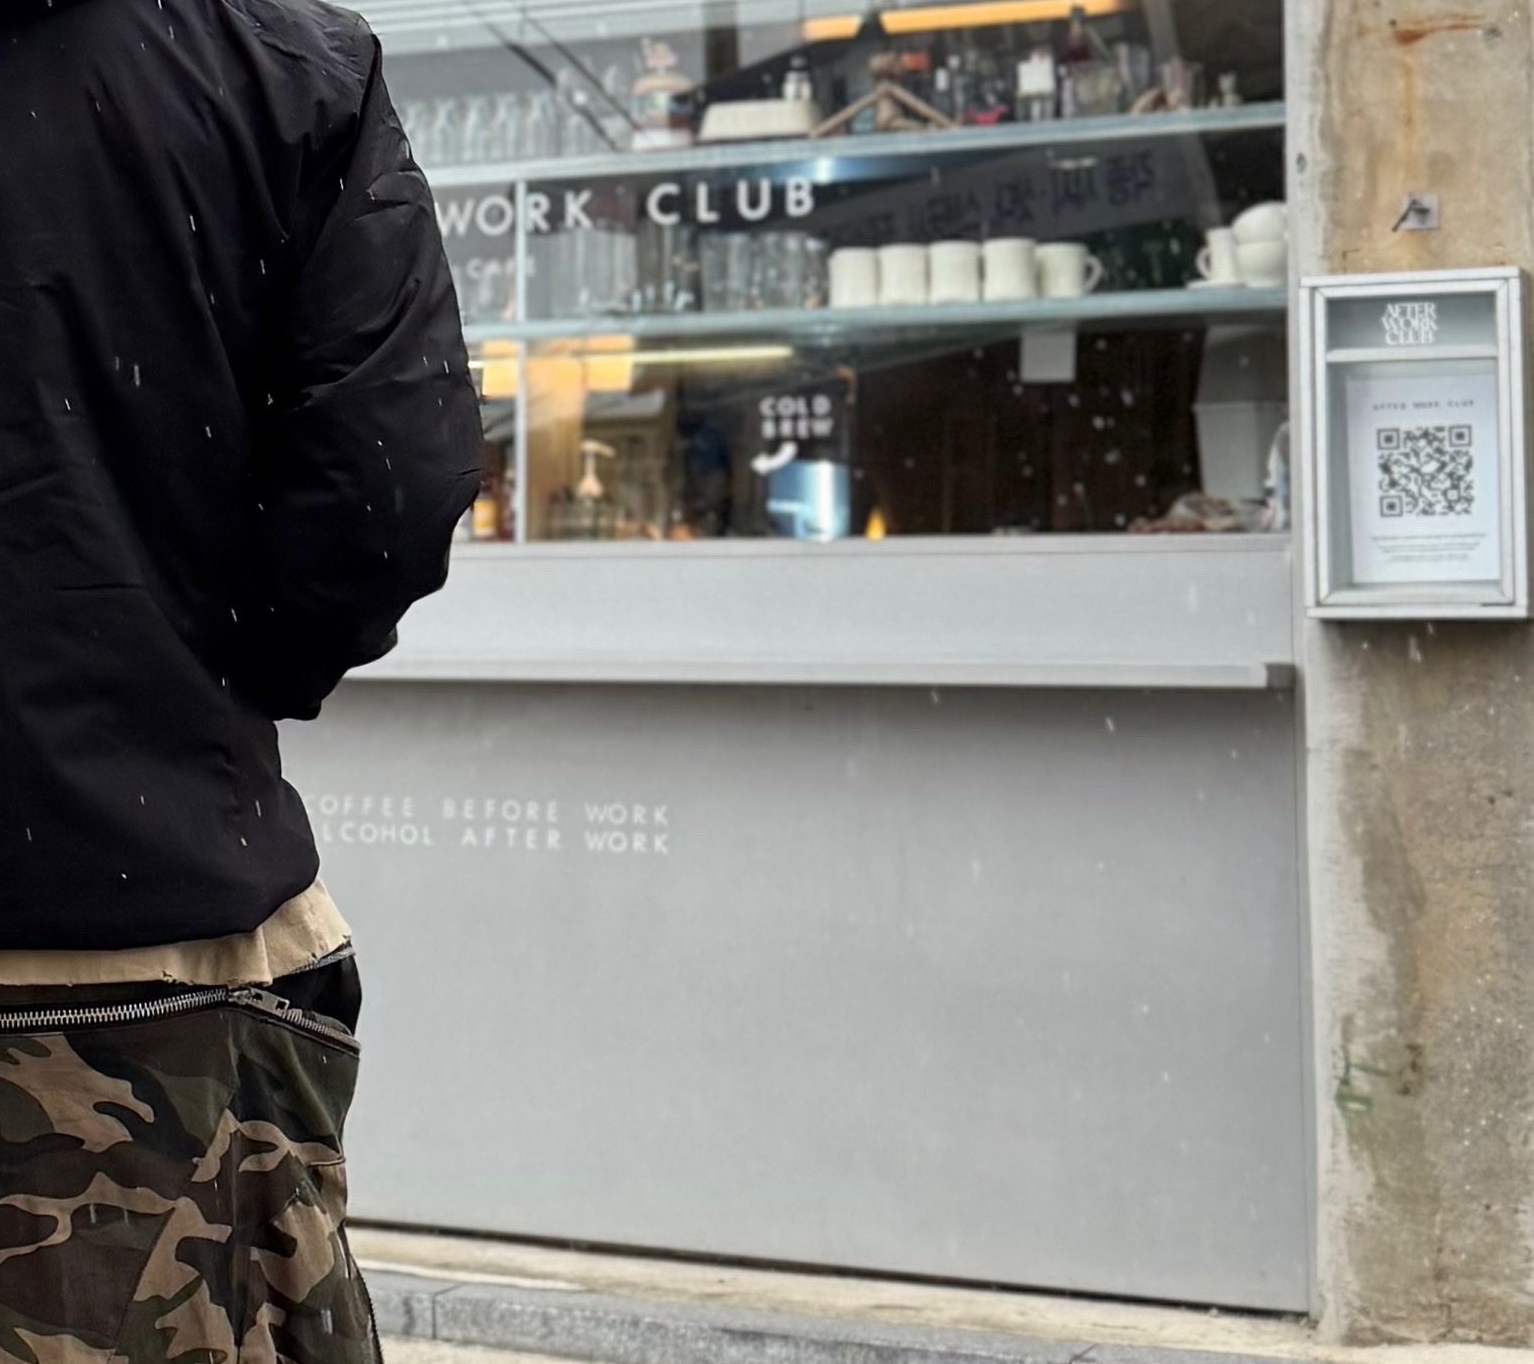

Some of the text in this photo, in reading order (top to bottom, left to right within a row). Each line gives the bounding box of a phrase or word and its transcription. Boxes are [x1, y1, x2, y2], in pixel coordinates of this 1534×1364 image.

[434, 189, 593, 237] WORK
[647, 178, 815, 226] CLUB
[1383, 302, 1437, 319] AFTER
[1381, 317, 1438, 334] WORK
[1385, 330, 1435, 345] CLUB
[758, 394, 832, 417] COLD
[760, 417, 834, 439] BREW
[442, 797, 560, 822] BEFORE
[584, 801, 669, 825] WORK
[315, 821, 669, 854] LCOHOL AFTER WORK
